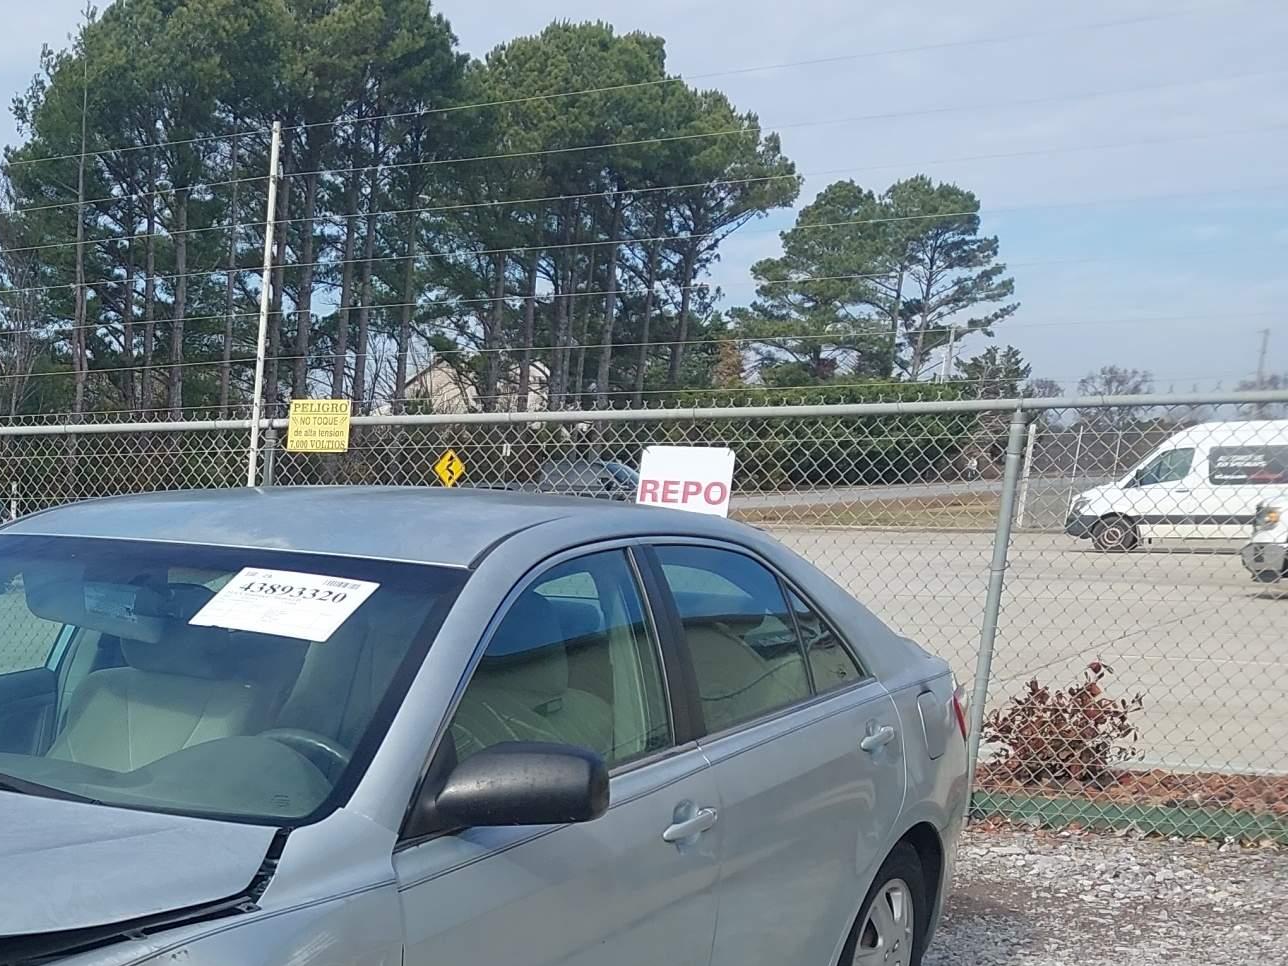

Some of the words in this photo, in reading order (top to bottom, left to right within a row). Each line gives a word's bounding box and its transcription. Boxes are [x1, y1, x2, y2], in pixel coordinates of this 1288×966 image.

[293, 402, 348, 413] PELIGRO
[299, 416, 311, 426] NO
[313, 416, 339, 426] TOQUE
[293, 428, 302, 437] de
[310, 440, 346, 449] VOLTIOS
[639, 479, 728, 506] REPO
[239, 581, 348, 604] 43893320
